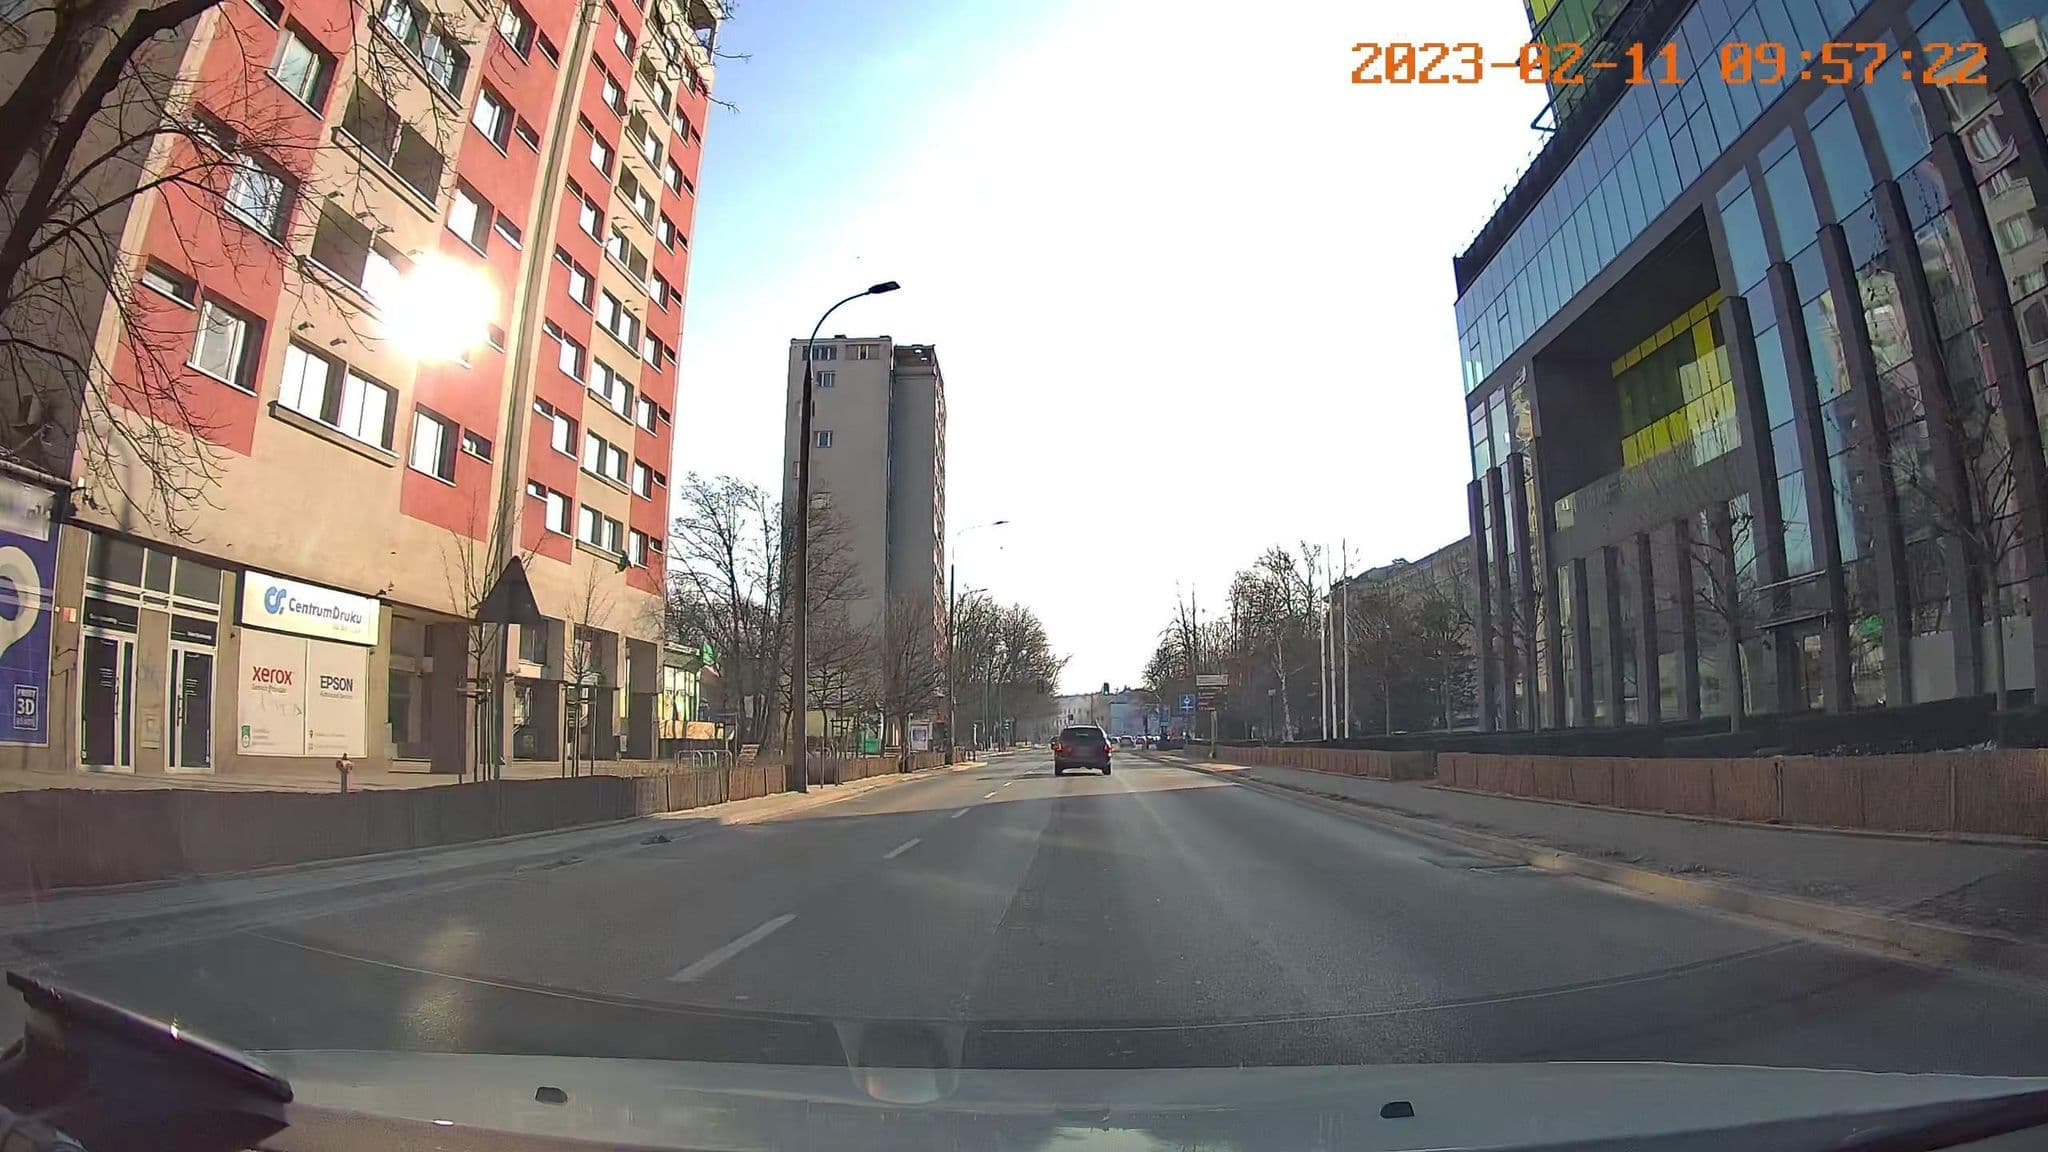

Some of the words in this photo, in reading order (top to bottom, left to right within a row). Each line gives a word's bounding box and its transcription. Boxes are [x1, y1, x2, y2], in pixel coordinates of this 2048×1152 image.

[288, 597, 363, 625] CentrumDruku
[252, 666, 293, 686] xerox
[320, 675, 353, 692] EPSON
[16, 697, 35, 715] 3D
